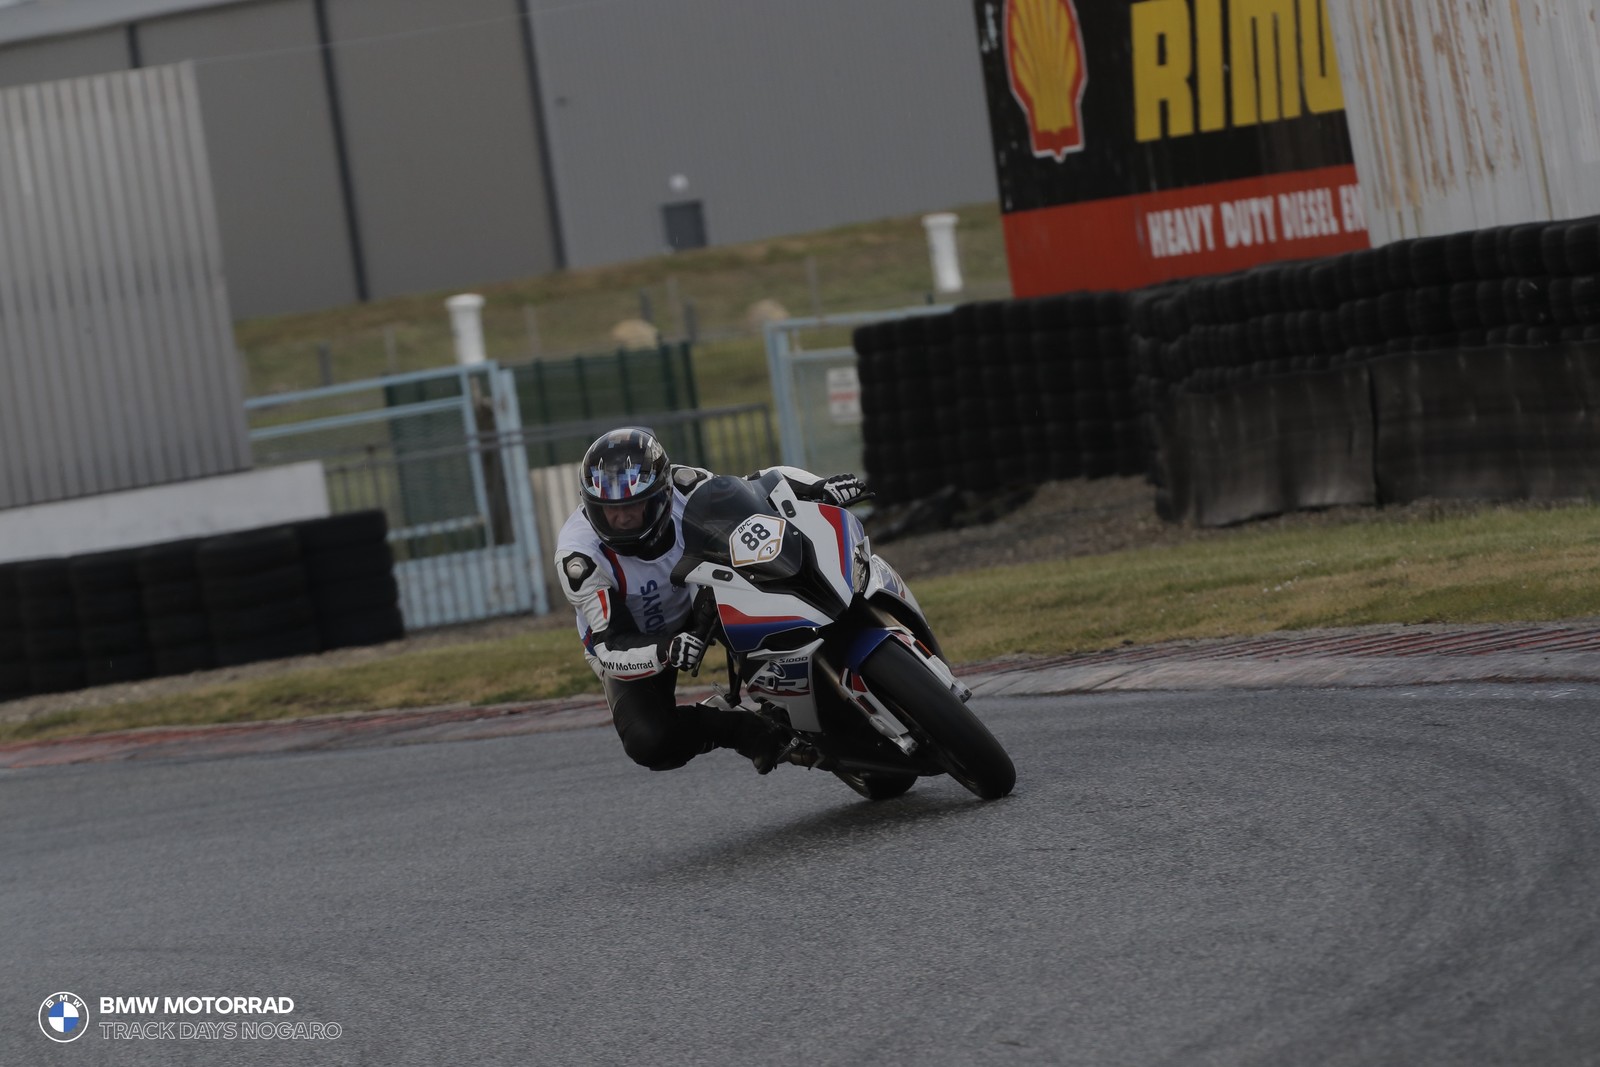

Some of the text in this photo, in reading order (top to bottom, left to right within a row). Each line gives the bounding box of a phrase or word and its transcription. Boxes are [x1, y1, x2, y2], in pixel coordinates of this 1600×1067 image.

[1146, 203, 1216, 259] HEAVY
[1220, 194, 1277, 249] DUTY
[1278, 187, 1340, 241] DIESEL
[740, 523, 771, 551] 88
[766, 546, 775, 555] 2
[615, 660, 654, 671] Motorrad
